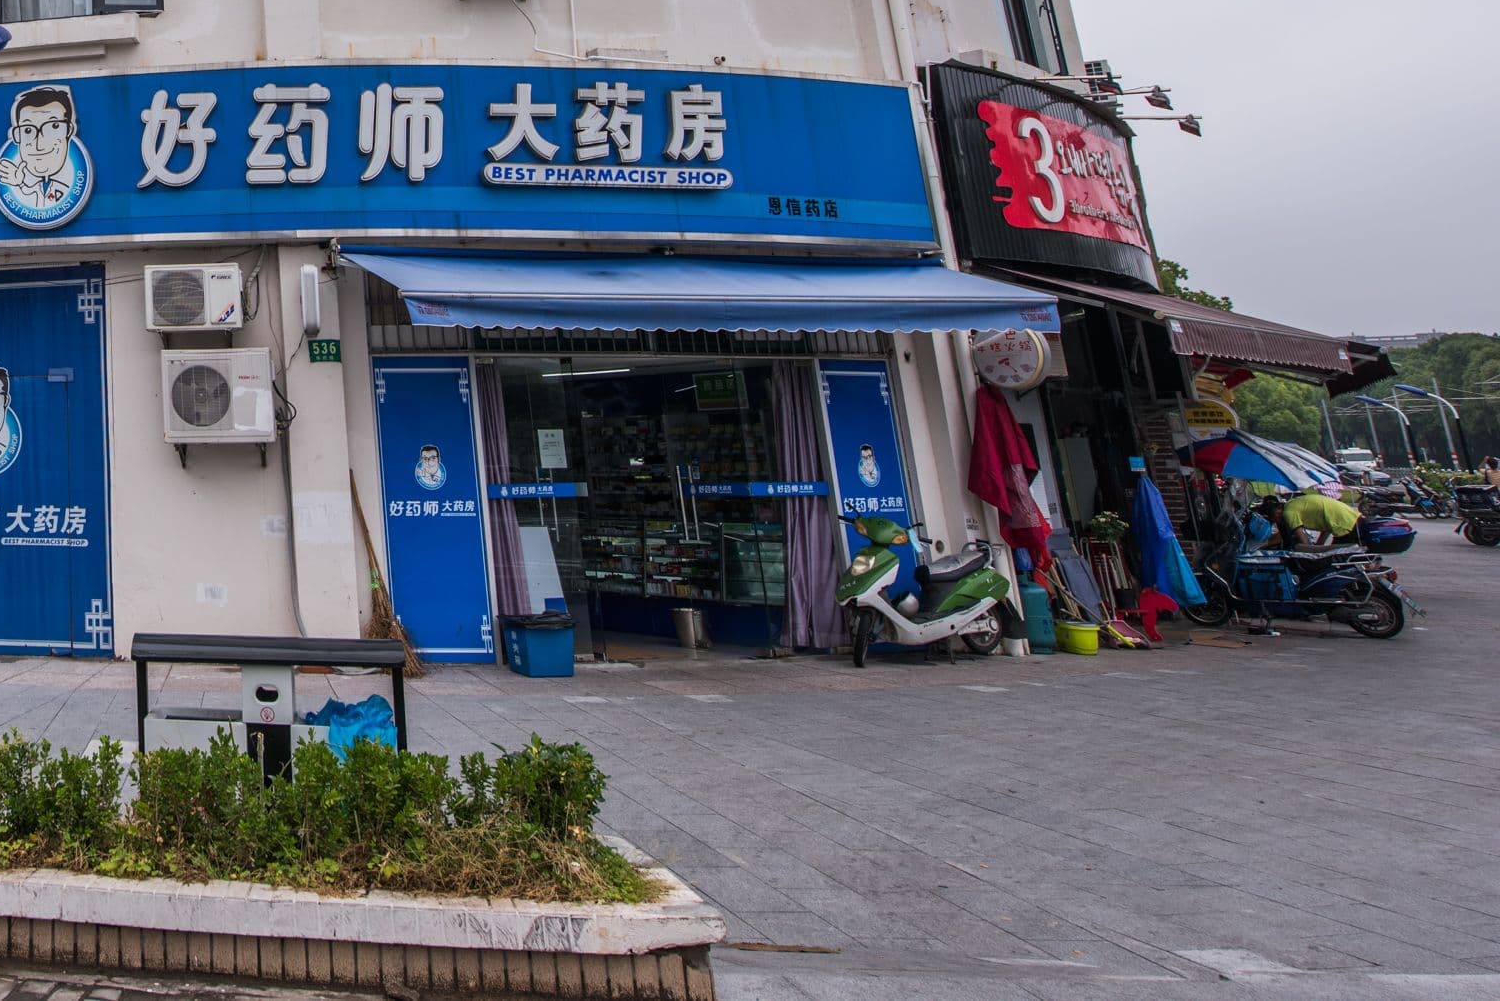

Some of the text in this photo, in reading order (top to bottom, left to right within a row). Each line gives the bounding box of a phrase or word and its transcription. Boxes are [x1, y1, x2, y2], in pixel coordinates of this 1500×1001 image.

[135, 81, 728, 189] 好药师大药房
[491, 165, 729, 186] BEST PHARMACIST SHOP
[1018, 117, 1065, 223] 3
[3, 170, 85, 220] BEST PHARMACIST SHOP
[768, 196, 838, 219] 恩信药店
[312, 342, 337, 355] 536
[9, 434, 19, 454] SHOP
[389, 500, 476, 517] 好药师大药房
